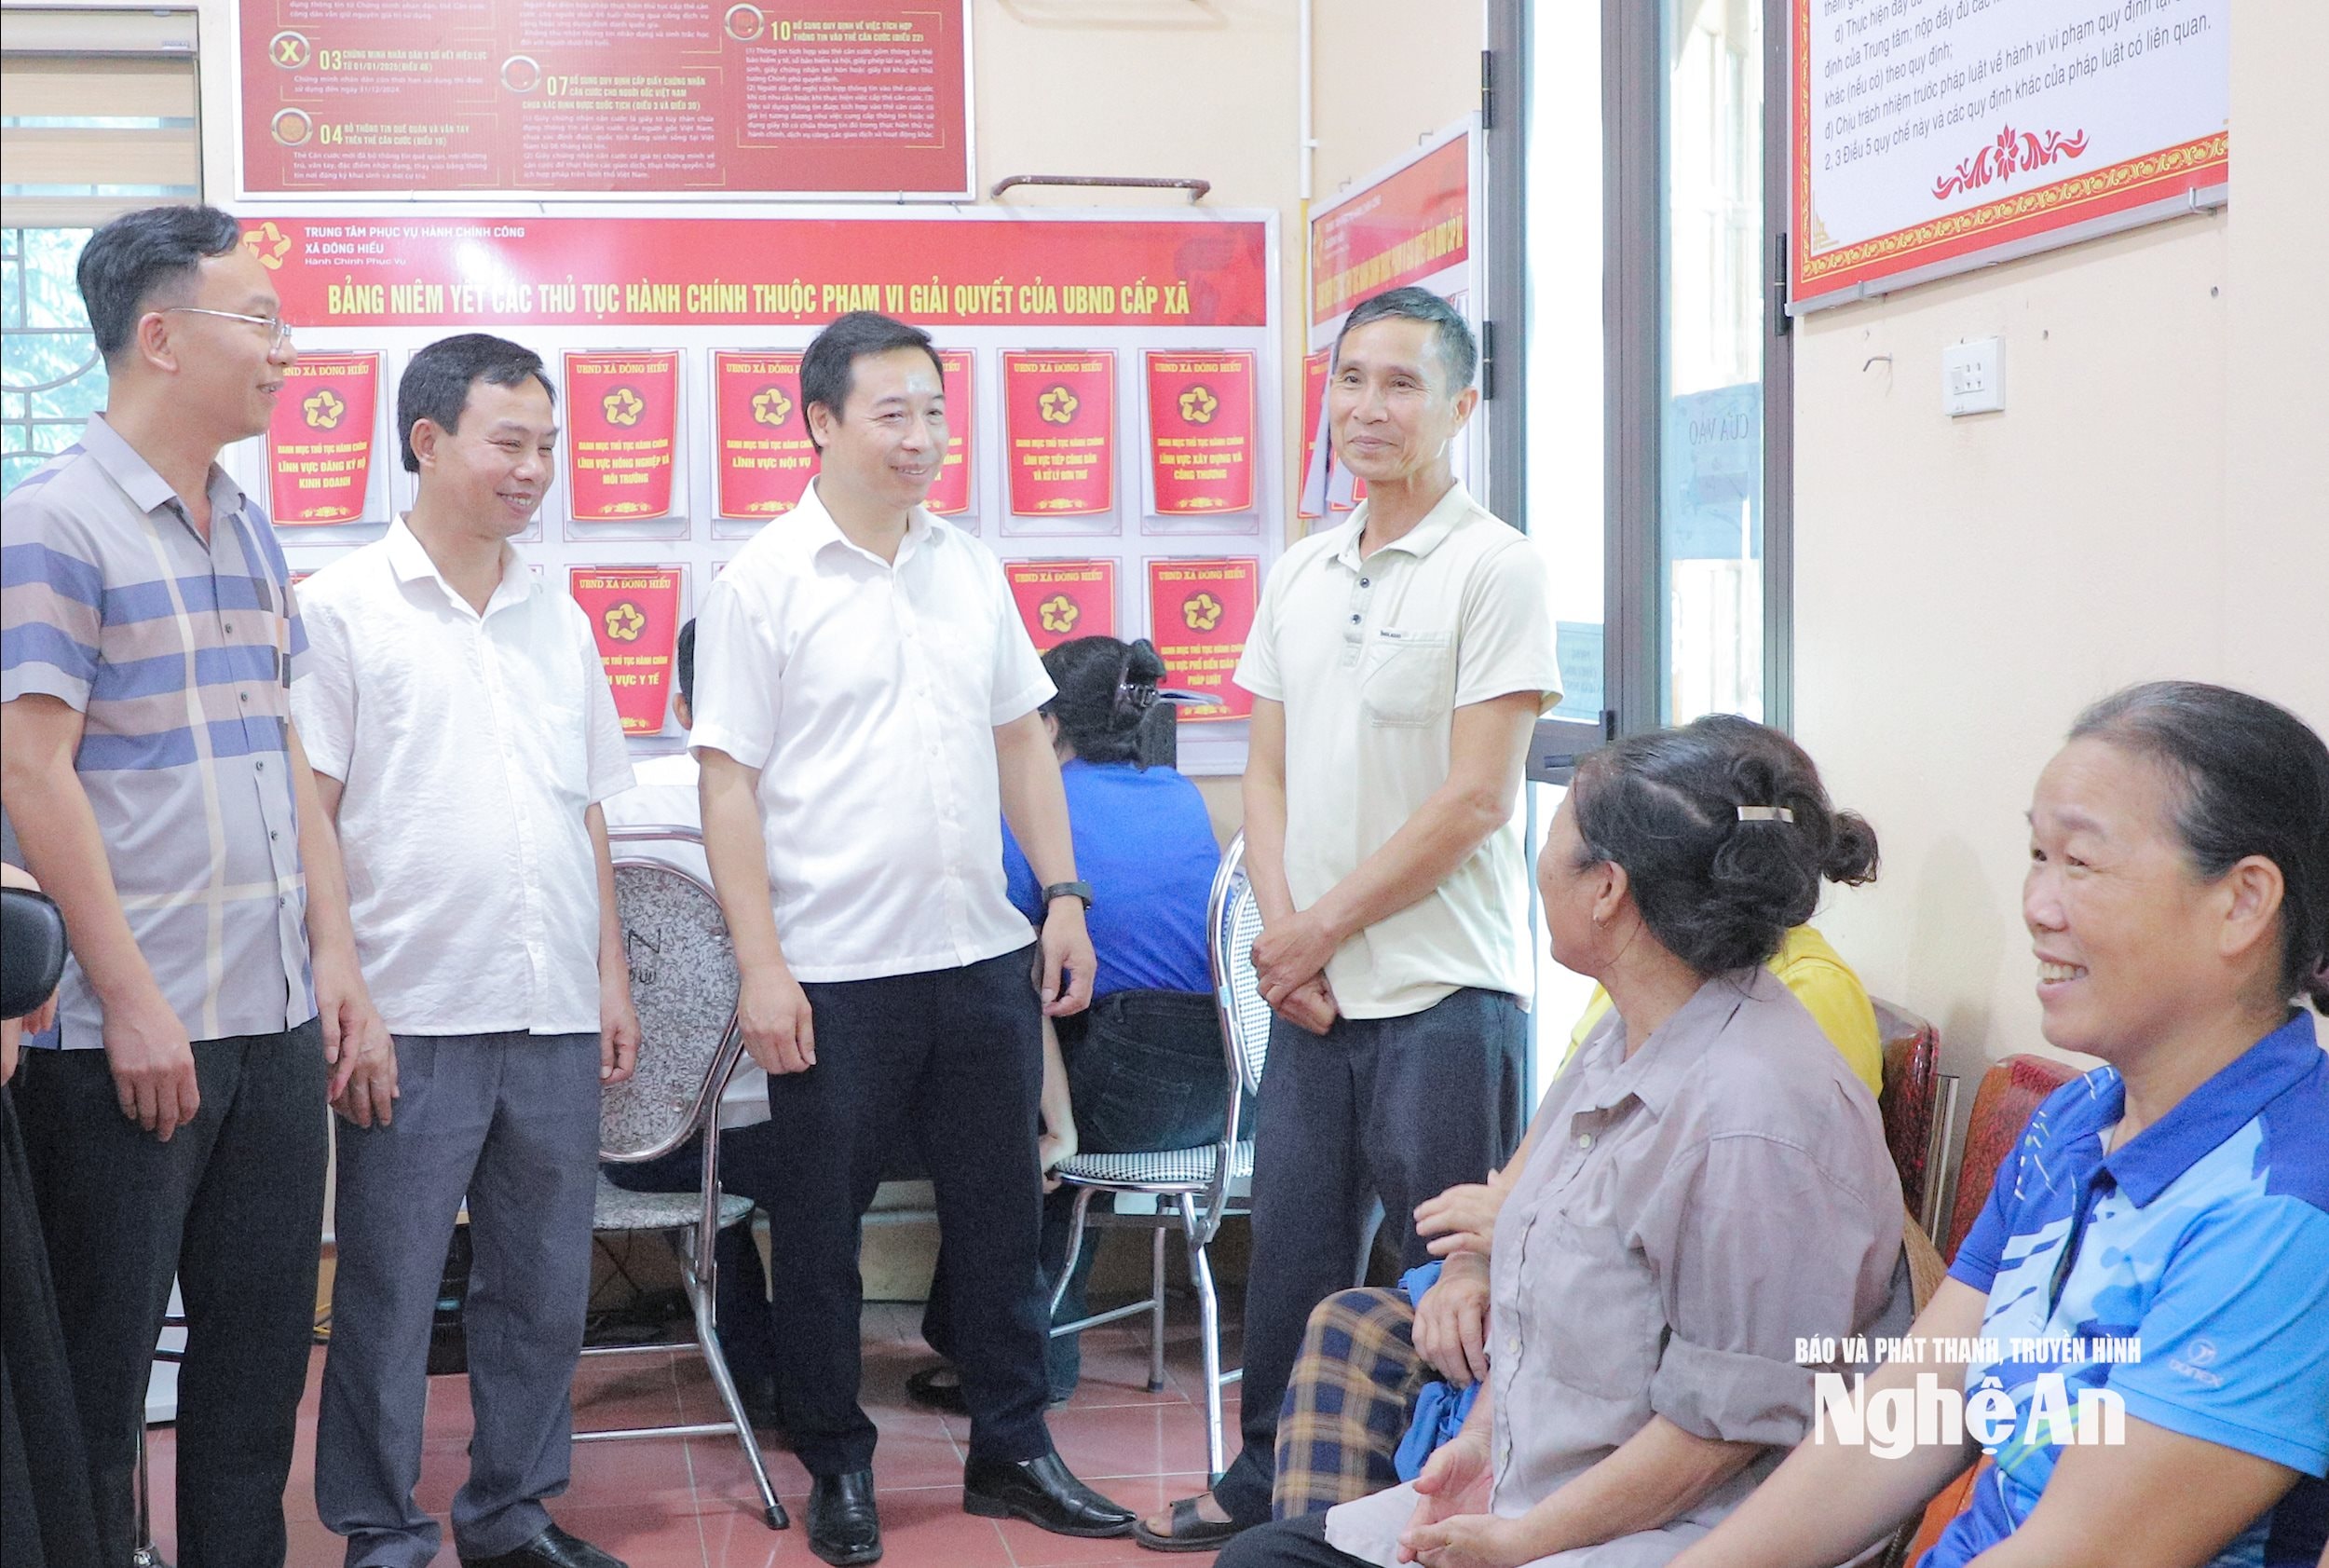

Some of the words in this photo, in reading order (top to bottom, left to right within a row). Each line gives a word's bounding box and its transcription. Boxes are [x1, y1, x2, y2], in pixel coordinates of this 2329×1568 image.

[1846, 16, 1868, 37] Thực
[1870, 5, 1889, 27] hiện
[770, 21, 791, 41] 10
[1824, 56, 1843, 80] định
[1845, 47, 1861, 70] của
[1863, 37, 1889, 60] Trung
[1892, 26, 1913, 48] tâm;
[1914, 17, 1933, 39] nộp
[320, 50, 341, 70] 03
[1825, 85, 1845, 109] khác
[1870, 69, 1884, 91] có)
[1886, 61, 1906, 84] theo
[1910, 53, 1927, 77] quy
[1836, 110, 1857, 135] Chịu
[1858, 103, 1880, 127] trách
[1883, 91, 1911, 116] nhiệm
[1914, 80, 1939, 105] trước
[1941, 69, 1966, 99] pháp
[1968, 60, 1987, 84] luật
[1990, 48, 2004, 75] về
[2006, 41, 2033, 71] hành
[2036, 34, 2046, 56] vi
[2050, 29, 2059, 50] vi
[2062, 19, 2095, 52] phạm
[2098, 8, 2120, 36] quy
[547, 76, 568, 95] 07
[1825, 153, 1833, 171] 2,
[1835, 148, 1842, 167] 3
[1866, 137, 1873, 156] 5
[1874, 136, 1891, 157] quy
[1893, 119, 1910, 145] chế
[1913, 117, 1929, 139] này
[1932, 109, 1945, 130] và
[1947, 103, 1966, 126] các
[1968, 97, 1986, 122] quy
[1989, 85, 2012, 112] định
[2015, 75, 2041, 100] khác
[2044, 63, 2065, 89] của
[2068, 53, 2097, 86] pháp
[2102, 42, 2124, 67] luật
[2128, 34, 2143, 58] có
[2147, 26, 2169, 51] liên
[2173, 15, 2211, 45] quan.
[320, 125, 343, 144] 04
[306, 226, 342, 239] TRUNG
[345, 225, 367, 238] TÂM
[369, 227, 402, 239] PHỤC
[403, 227, 419, 239] VỤ
[421, 225, 454, 238] HÀNH
[457, 225, 491, 238] CHÍNH
[494, 225, 526, 239] CÔNG
[306, 240, 320, 254] XÃ
[358, 240, 385, 254] HIẾU
[306, 257, 331, 266] Hành
[328, 274, 385, 314] BẢNG
[391, 279, 443, 314] NIÊM
[451, 277, 484, 314] YẾT
[491, 278, 532, 314] CÁC
[538, 274, 576, 314] THỦ
[581, 283, 620, 320] TỤC
[626, 278, 680, 313] HÀNH
[687, 278, 745, 313] CHÍNH
[753, 278, 817, 319] THUỘC
[885, 284, 904, 313] VI
[909, 276, 949, 314] GIẢI
[954, 276, 1014, 318] QUYẾT
[1019, 276, 1058, 314] CỦA
[1063, 285, 1116, 314] UBND
[1121, 276, 1159, 314] CẤP
[1164, 280, 1190, 314] XÃ
[577, 364, 601, 373] UBND
[756, 457, 777, 470] VỰC
[779, 456, 797, 470] NỘI
[299, 477, 321, 488] KINH
[579, 579, 604, 589] UBND
[616, 673, 636, 687] VỰC
[639, 675, 647, 686] Y
[648, 672, 660, 686] TẾ
